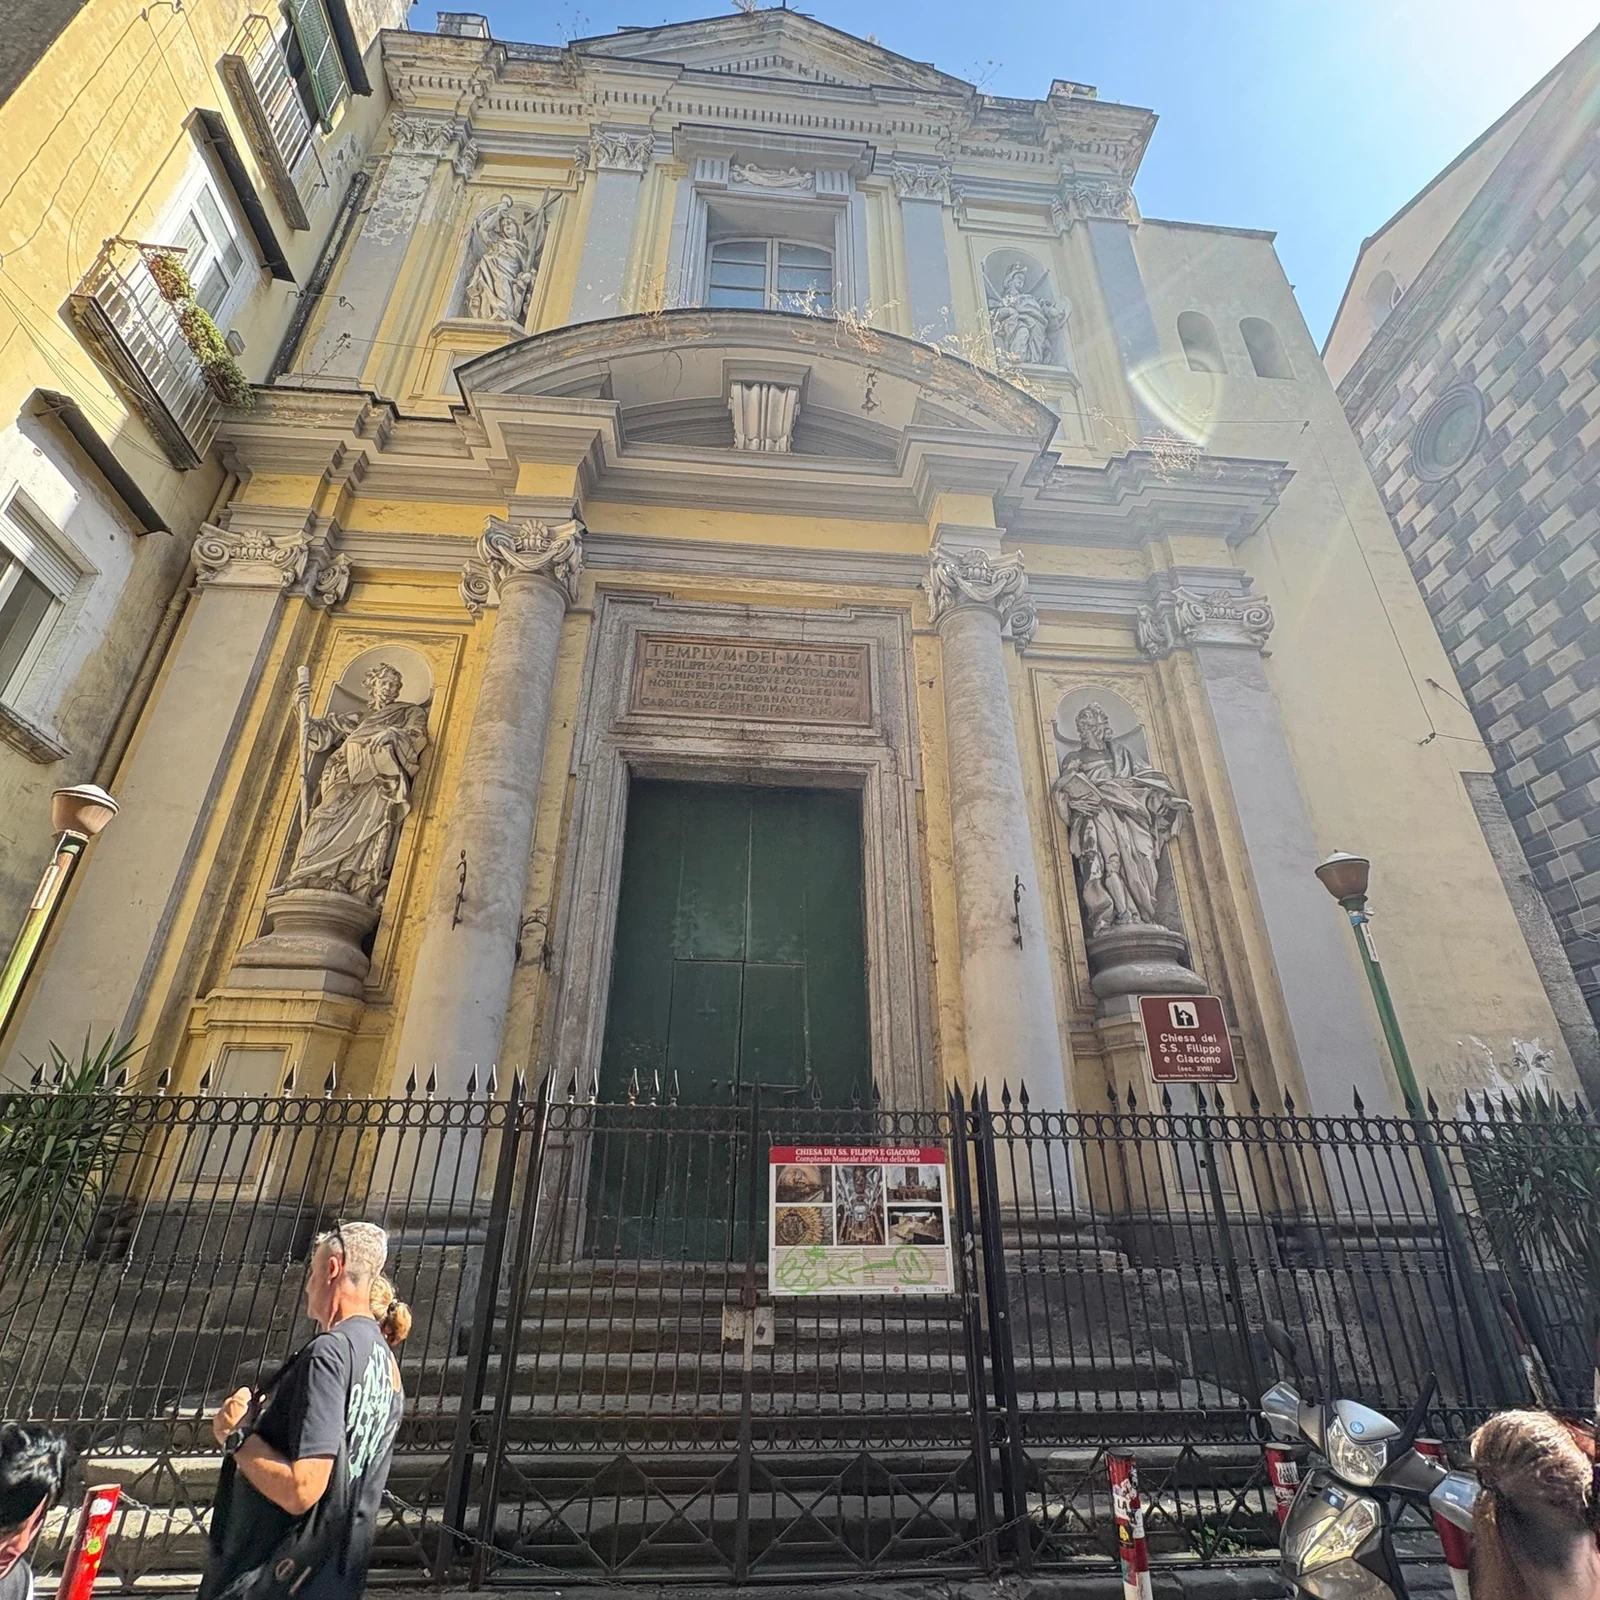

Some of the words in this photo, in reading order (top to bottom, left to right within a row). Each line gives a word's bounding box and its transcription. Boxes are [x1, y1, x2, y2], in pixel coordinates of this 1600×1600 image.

[650, 644, 737, 661] TEMPLVM
[746, 649, 776, 664] DEI
[786, 652, 857, 669] MATRIS
[645, 658, 660, 668] ET
[710, 662, 726, 672] AC
[657, 670, 702, 680] NOMINE
[649, 679, 692, 689] NOBILE
[641, 697, 689, 708] CAROLO
[1160, 1033, 1196, 1043] Chiesa
[1201, 1033, 1217, 1043] dei
[1159, 1043, 1181, 1053] S.S.
[1186, 1044, 1221, 1055] Filippo
[1176, 1054, 1221, 1064] Giacomo
